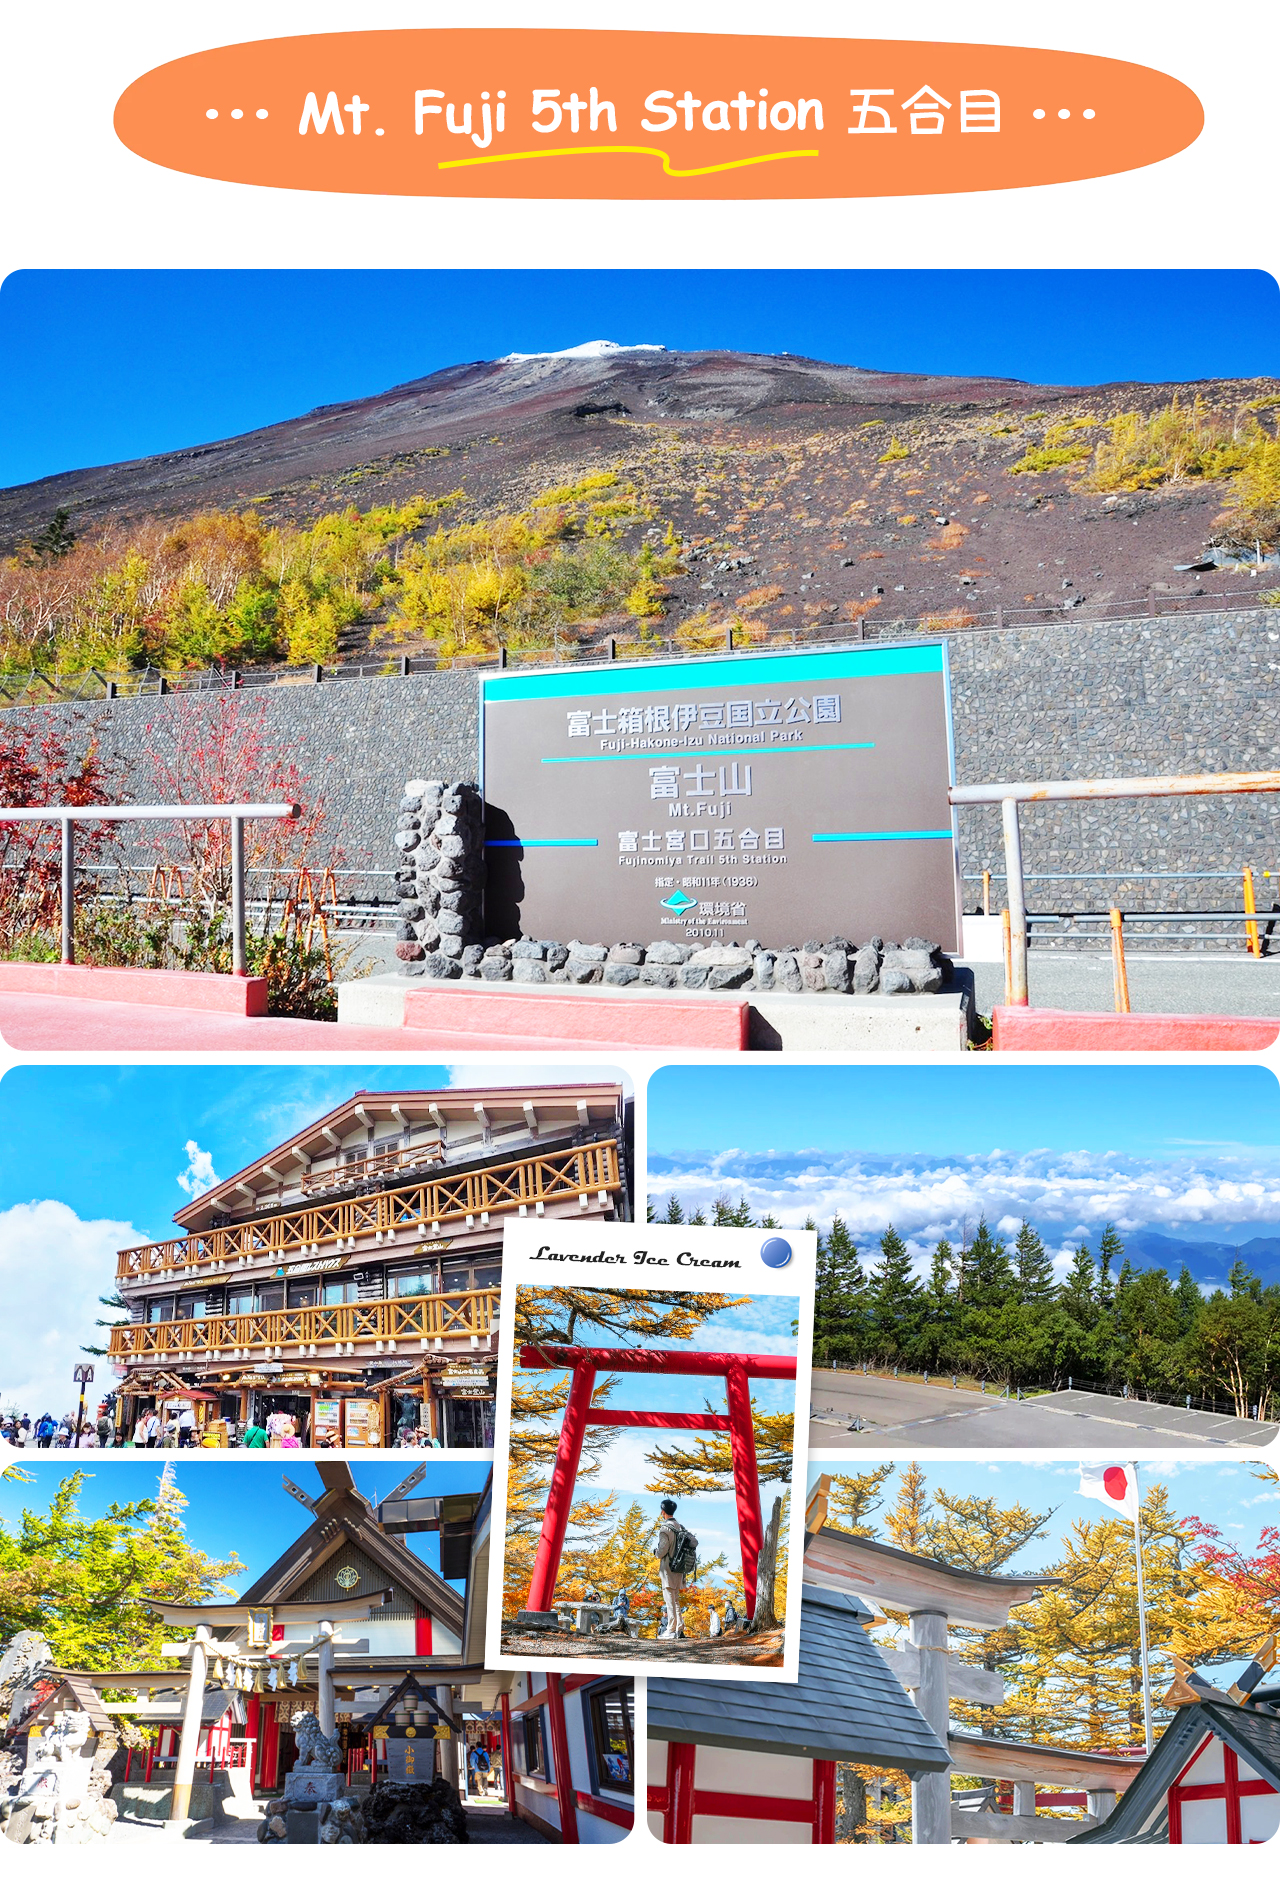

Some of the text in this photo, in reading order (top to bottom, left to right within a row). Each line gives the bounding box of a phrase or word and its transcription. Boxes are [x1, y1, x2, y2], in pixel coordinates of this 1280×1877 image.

[566, 694, 841, 738] 富士箱根伊豆国立公園
[600, 729, 803, 752] Fuji-Hakone-Izu National Park
[649, 761, 752, 799] 富士山
[668, 801, 732, 818] Mt.Fuji
[618, 827, 785, 852] 富士宮口五合目
[618, 853, 788, 867] Fujinomiya Trail 5th Station
[699, 901, 747, 917] 環境省
[660, 917, 687, 926] Ministry
[707, 917, 749, 925] Environment
[685, 928, 725, 938] 2010.11
